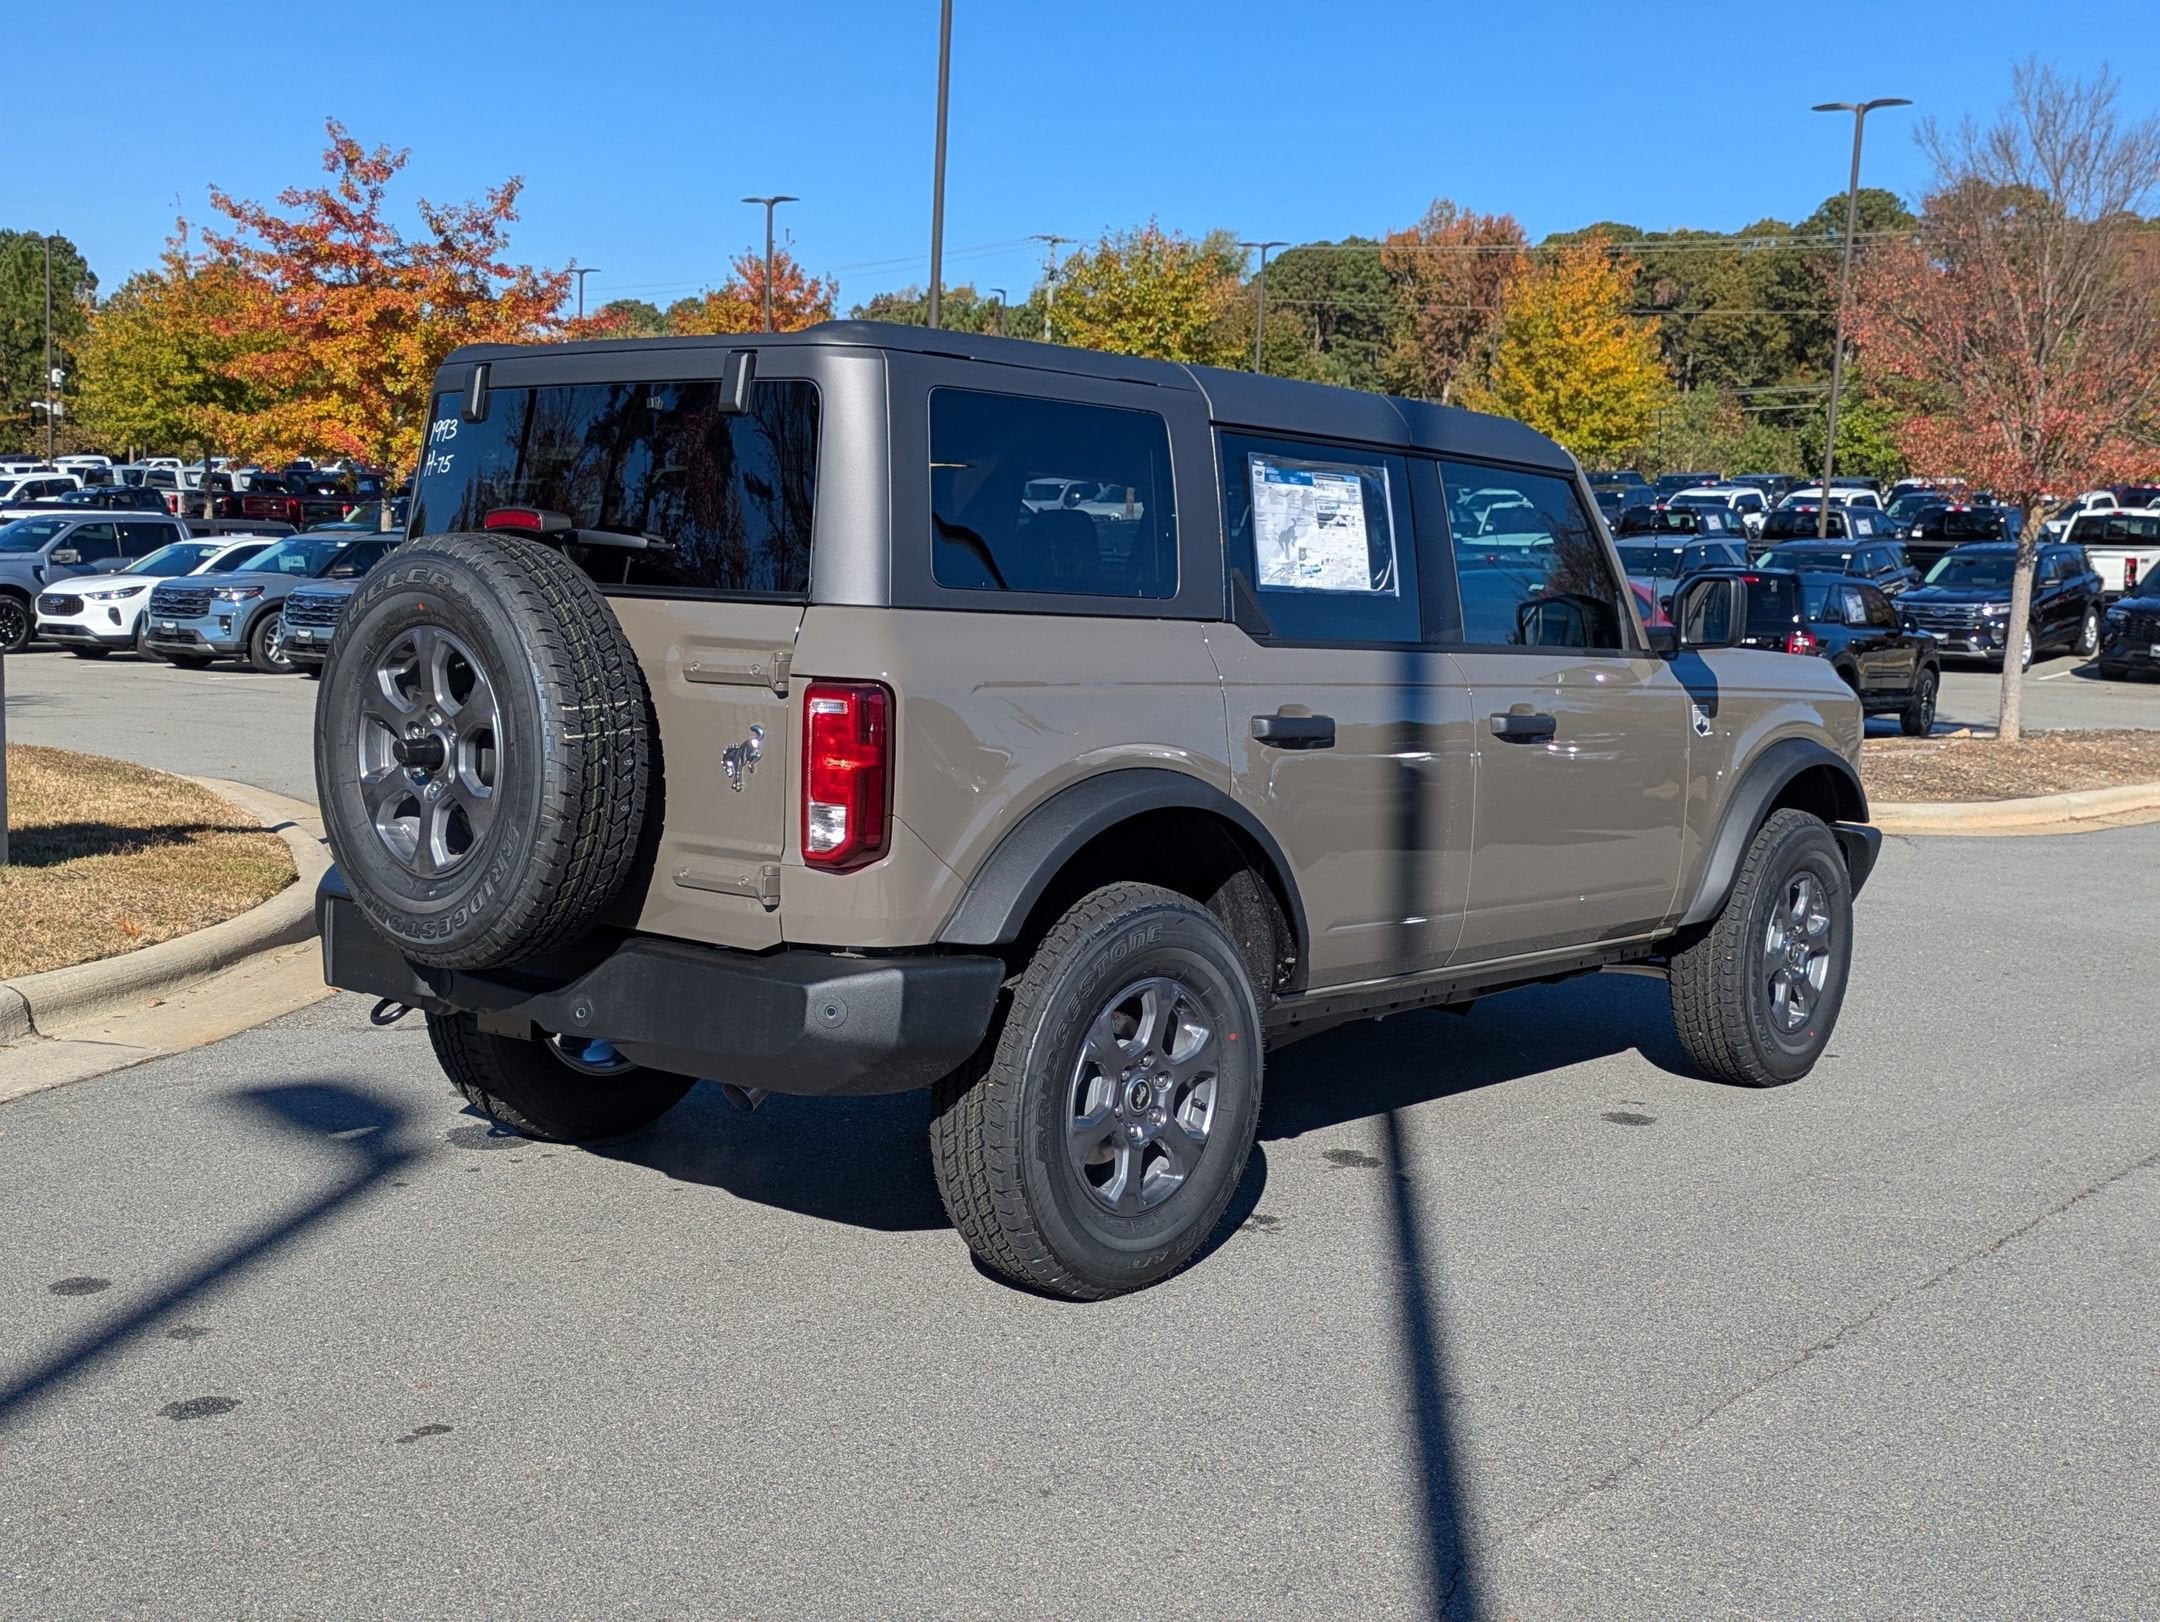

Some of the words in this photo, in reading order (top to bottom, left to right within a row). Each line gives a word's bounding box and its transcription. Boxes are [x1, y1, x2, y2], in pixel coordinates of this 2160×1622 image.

[428, 418, 458, 446] 1993
[358, 818, 520, 938] BRIDGESTONE
[1035, 922, 1164, 1164] BRIDGESTONE
